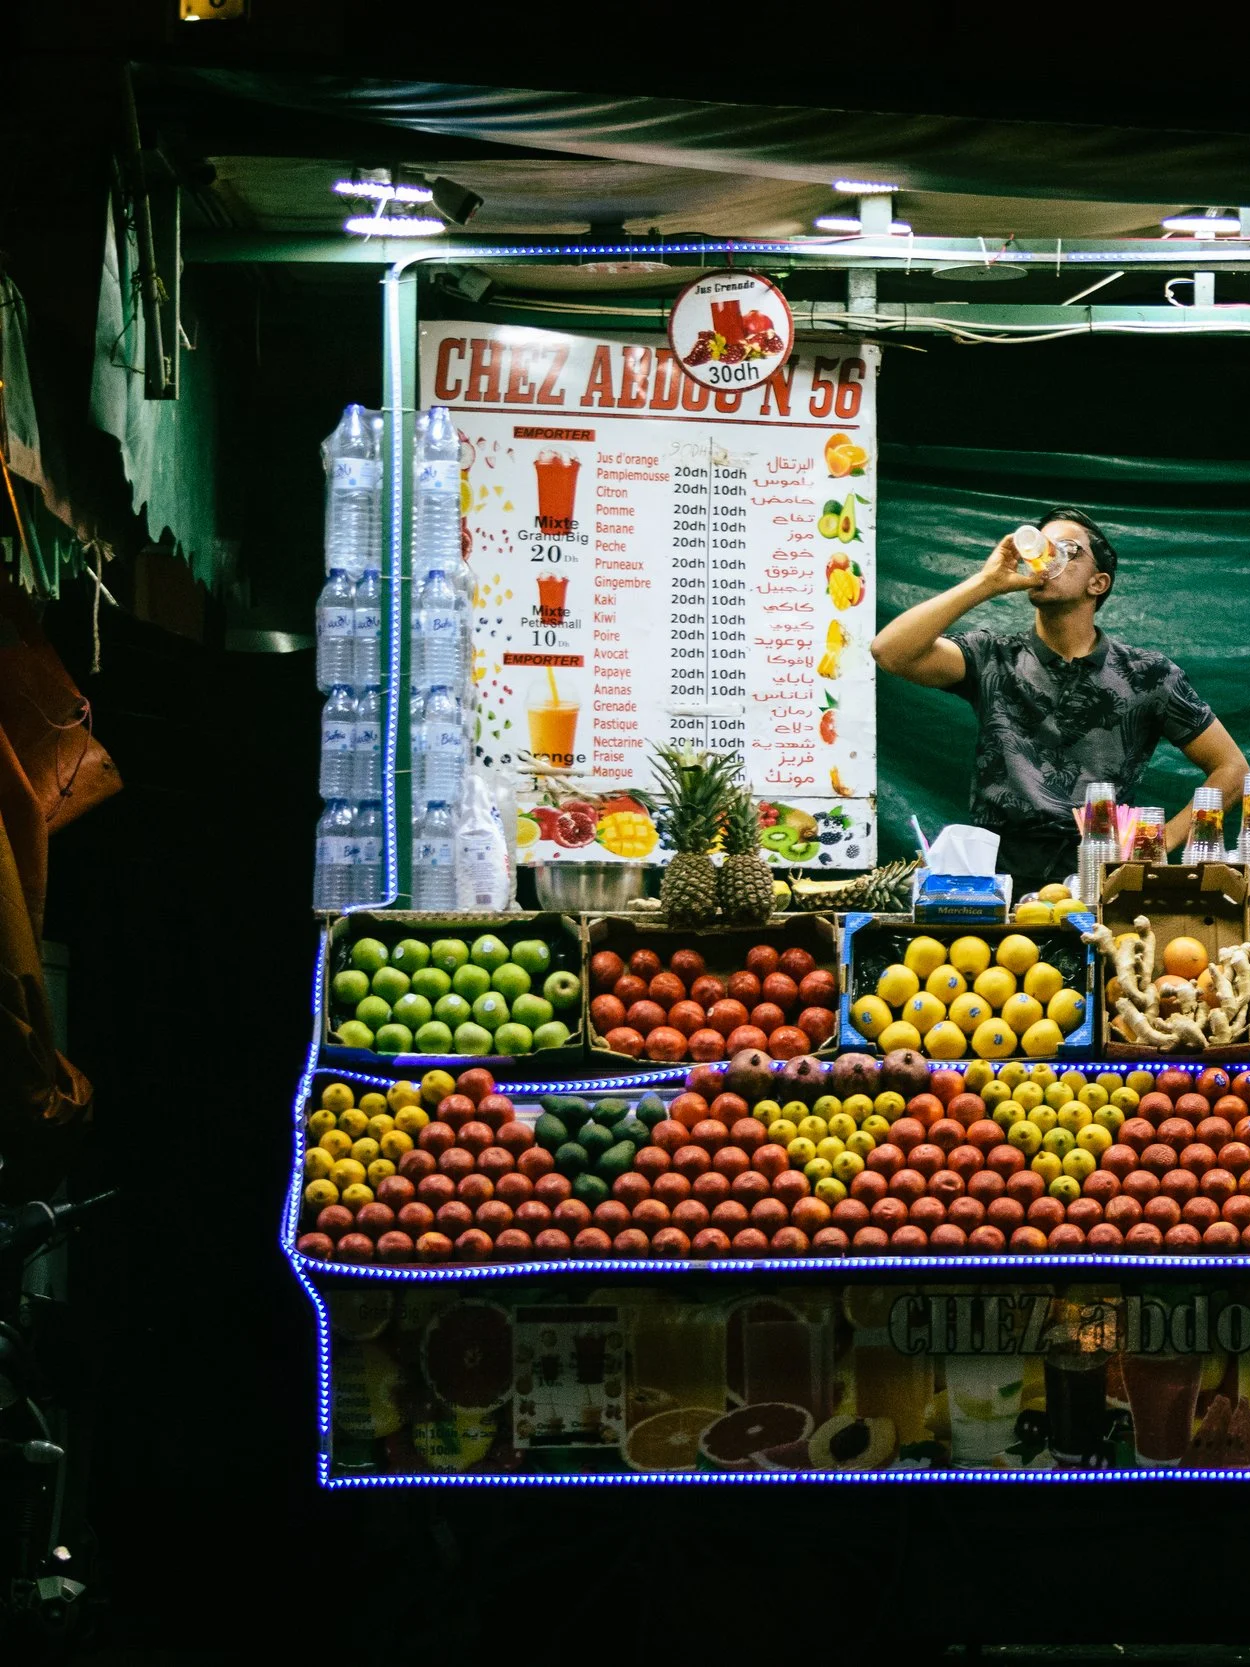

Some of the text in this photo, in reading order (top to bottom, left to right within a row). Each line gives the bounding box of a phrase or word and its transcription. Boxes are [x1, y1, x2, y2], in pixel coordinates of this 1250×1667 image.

[694, 279, 755, 295] Jus Grenade
[434, 337, 568, 405] CHEZ
[810, 356, 865, 419] 56
[709, 362, 760, 385] 30dh
[514, 426, 591, 440] EMPORTER
[597, 452, 659, 468] Jus d'orange
[767, 455, 815, 474] البرتقال
[597, 466, 747, 484] Pamplemousse 20dh 10dh
[596, 483, 747, 499] Citron 20dh 10dh
[751, 494, 816, 506] حامض
[596, 503, 747, 517] Pomme 20dh 10dh
[534, 516, 579, 530] Mixte
[772, 514, 815, 525] تفاح
[595, 520, 746, 535] Banane 20dh 10dh
[787, 531, 815, 543] موز
[595, 537, 746, 553] Peche 20dh 10dh
[530, 545, 562, 563] 20
[772, 548, 815, 560] خوخ
[595, 557, 746, 571] Pruneaux 20dh 10dh
[764, 566, 814, 579] برقوق
[594, 575, 746, 591] Gingembre 20dh 10dh
[756, 583, 814, 595] زنجبيل
[594, 593, 746, 607] Kaki 20dh 10dh
[532, 605, 571, 618] Mixte
[763, 602, 814, 614] كاكي
[593, 611, 746, 625] Kiwi 20dh 10dh
[769, 621, 815, 632] كيوي
[532, 630, 556, 647] 10
[593, 630, 746, 642] Poire 20dh 10dh
[503, 654, 579, 666] EMPORTER
[593, 647, 746, 660] Avocat 20dh 10dh
[767, 655, 814, 668] لافوكا
[594, 666, 746, 680] Papaye 20dh 10dh
[594, 683, 746, 696] Ananas 20dh 10dh
[593, 700, 637, 712] Grenade
[771, 705, 813, 718] رمان
[593, 718, 746, 733] Pastique 20dh 10dh
[774, 721, 814, 734] دلاح
[593, 736, 644, 748] Nectarine
[710, 737, 745, 748] 10dh
[592, 751, 625, 762] Fraise
[778, 751, 815, 767] فريز
[592, 767, 633, 780] Mangue
[937, 906, 983, 915] Marchica
[888, 1294, 1053, 1357] CHEZ
